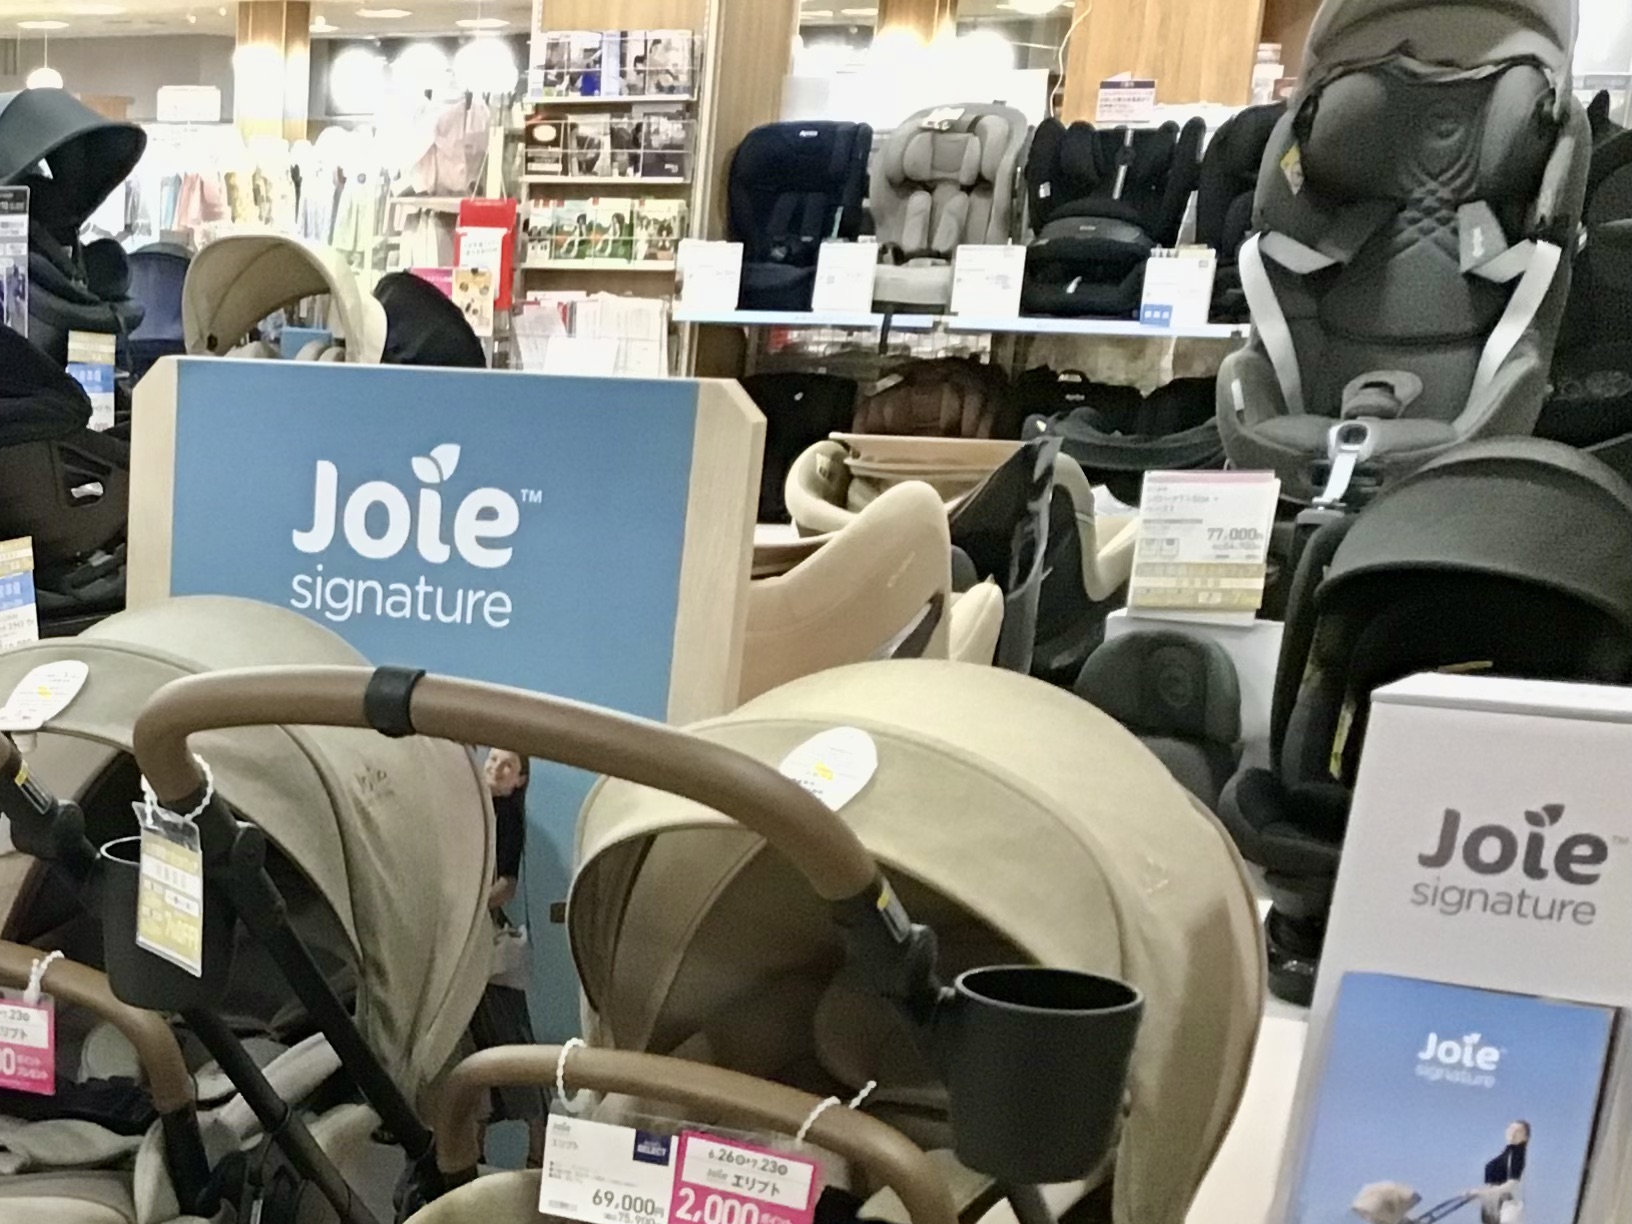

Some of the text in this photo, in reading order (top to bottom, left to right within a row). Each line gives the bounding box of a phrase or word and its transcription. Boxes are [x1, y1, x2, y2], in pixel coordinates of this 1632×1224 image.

[292, 443, 520, 570] Joie
[290, 564, 513, 628] signature
[1418, 803, 1609, 886] Joie
[1410, 875, 1596, 926] signature
[1417, 1031, 1502, 1072] Joie
[731, 1174, 781, 1196] エリプト
